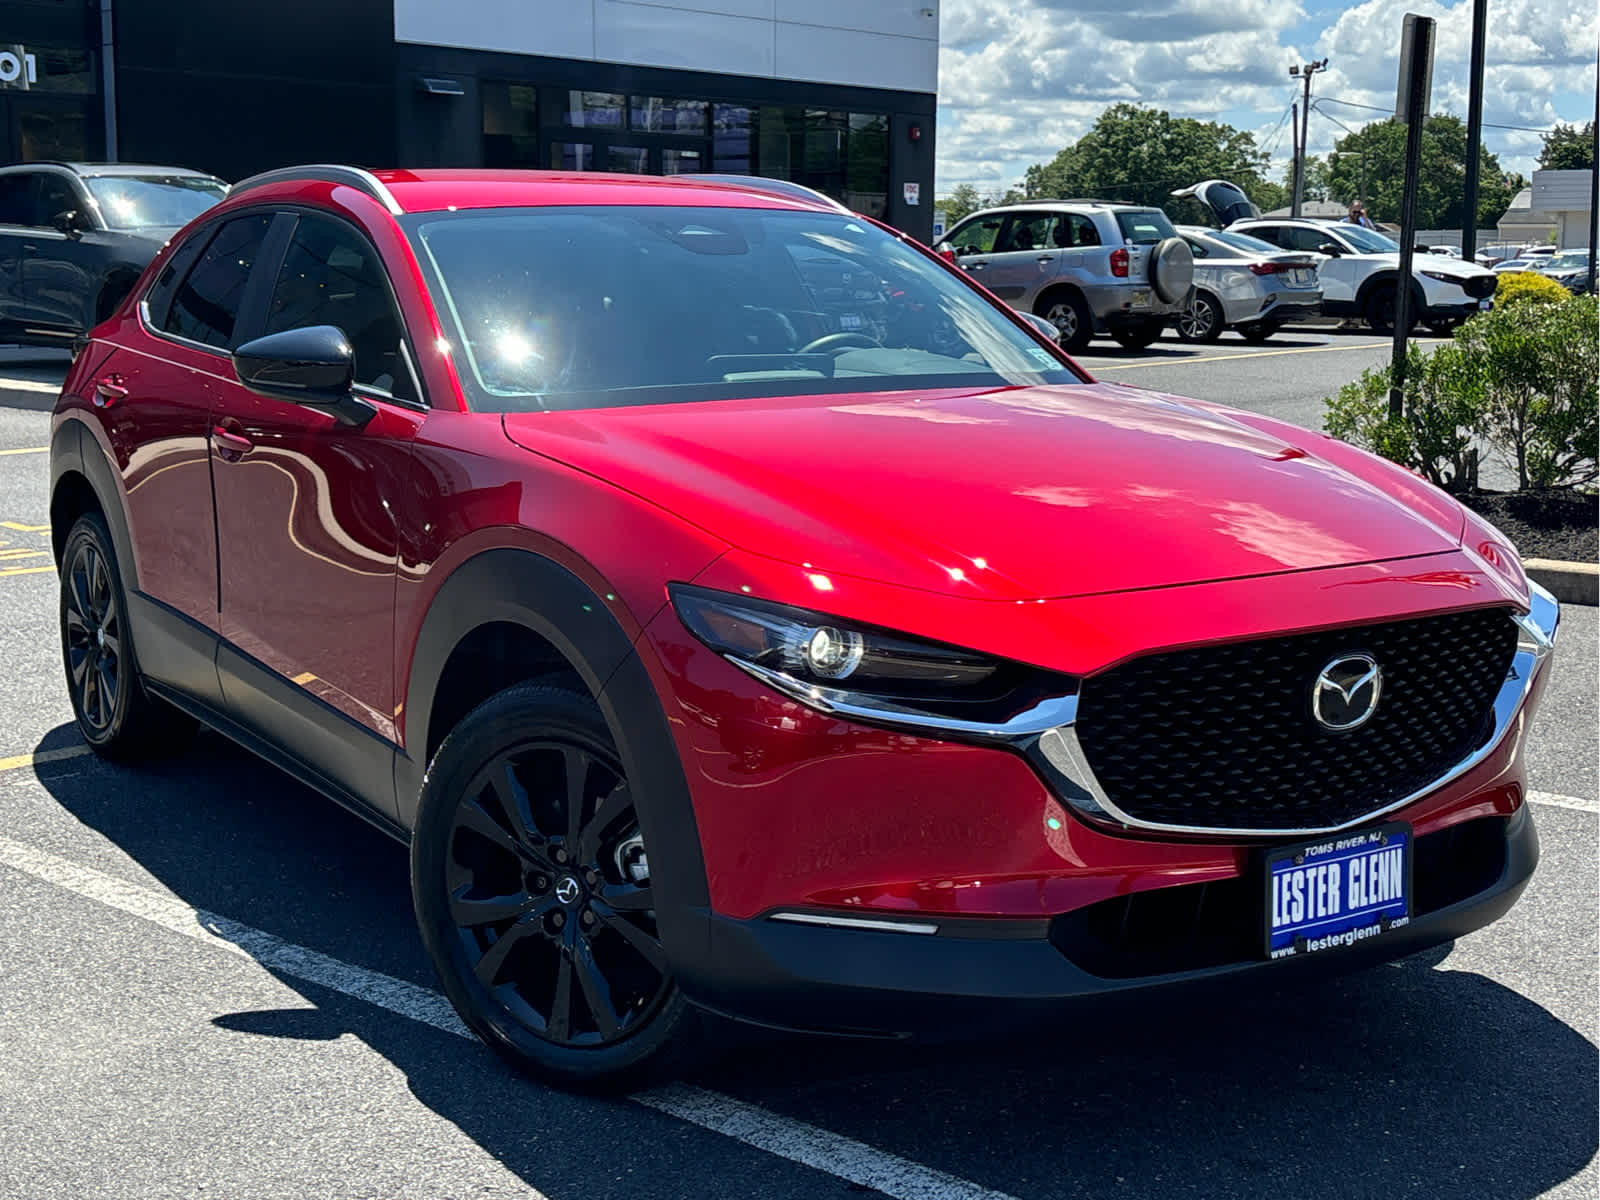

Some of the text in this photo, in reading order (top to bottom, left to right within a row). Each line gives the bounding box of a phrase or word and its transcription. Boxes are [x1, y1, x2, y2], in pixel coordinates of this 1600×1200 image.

[1304, 842, 1334, 857] TOMS
[1369, 832, 1382, 842] NJ
[1272, 847, 1402, 928] LESTER GLENN
[1271, 946, 1297, 959] www.
[1306, 924, 1381, 952] lesterglenn
